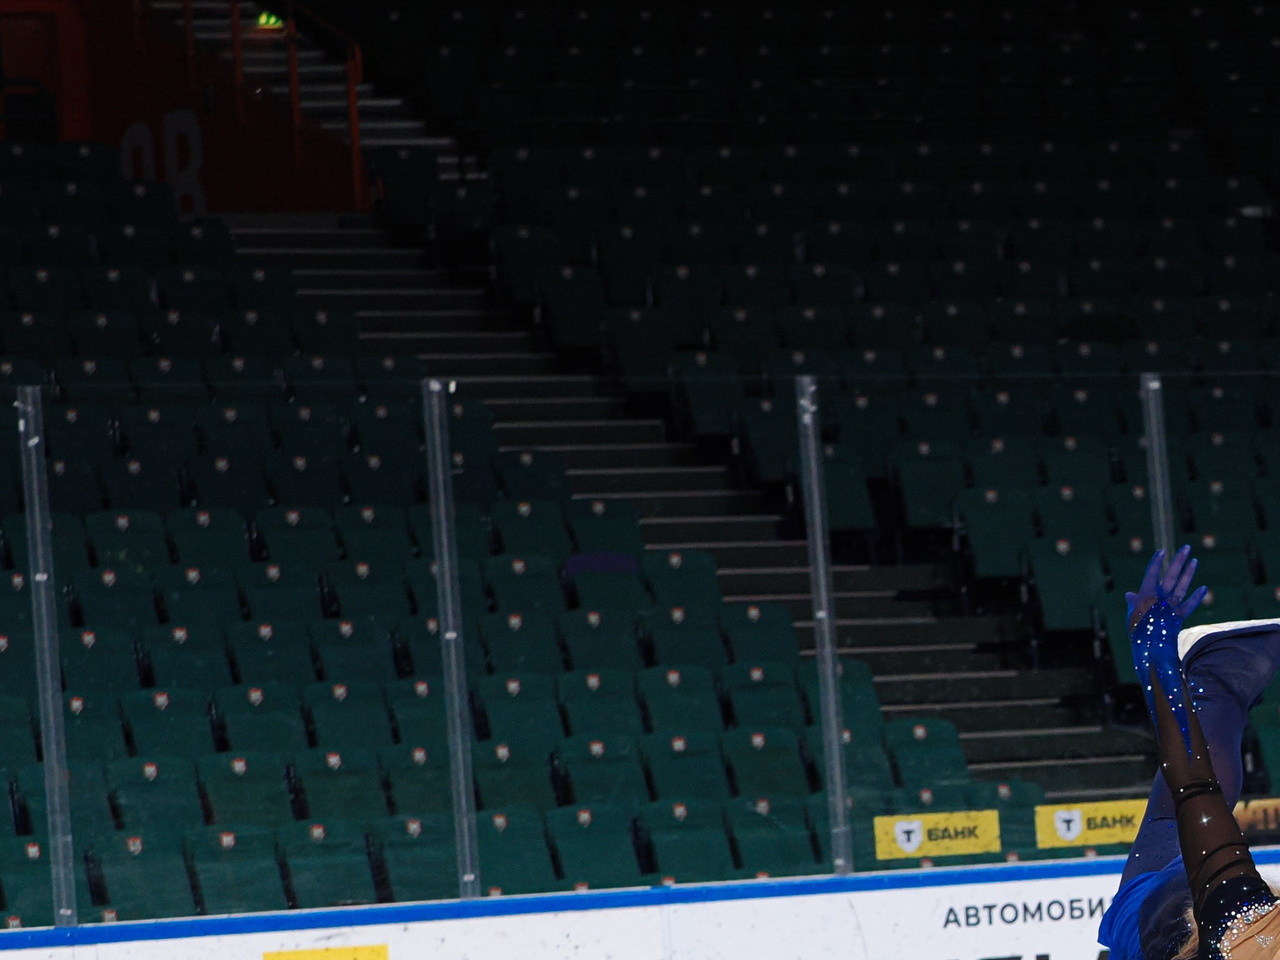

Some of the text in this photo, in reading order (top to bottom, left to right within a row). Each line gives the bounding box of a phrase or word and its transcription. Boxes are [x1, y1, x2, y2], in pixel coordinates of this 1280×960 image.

[1086, 815, 1135, 831] БАНК
[927, 826, 978, 841] БАНК
[943, 897, 1113, 929] АВТОМОБИ
